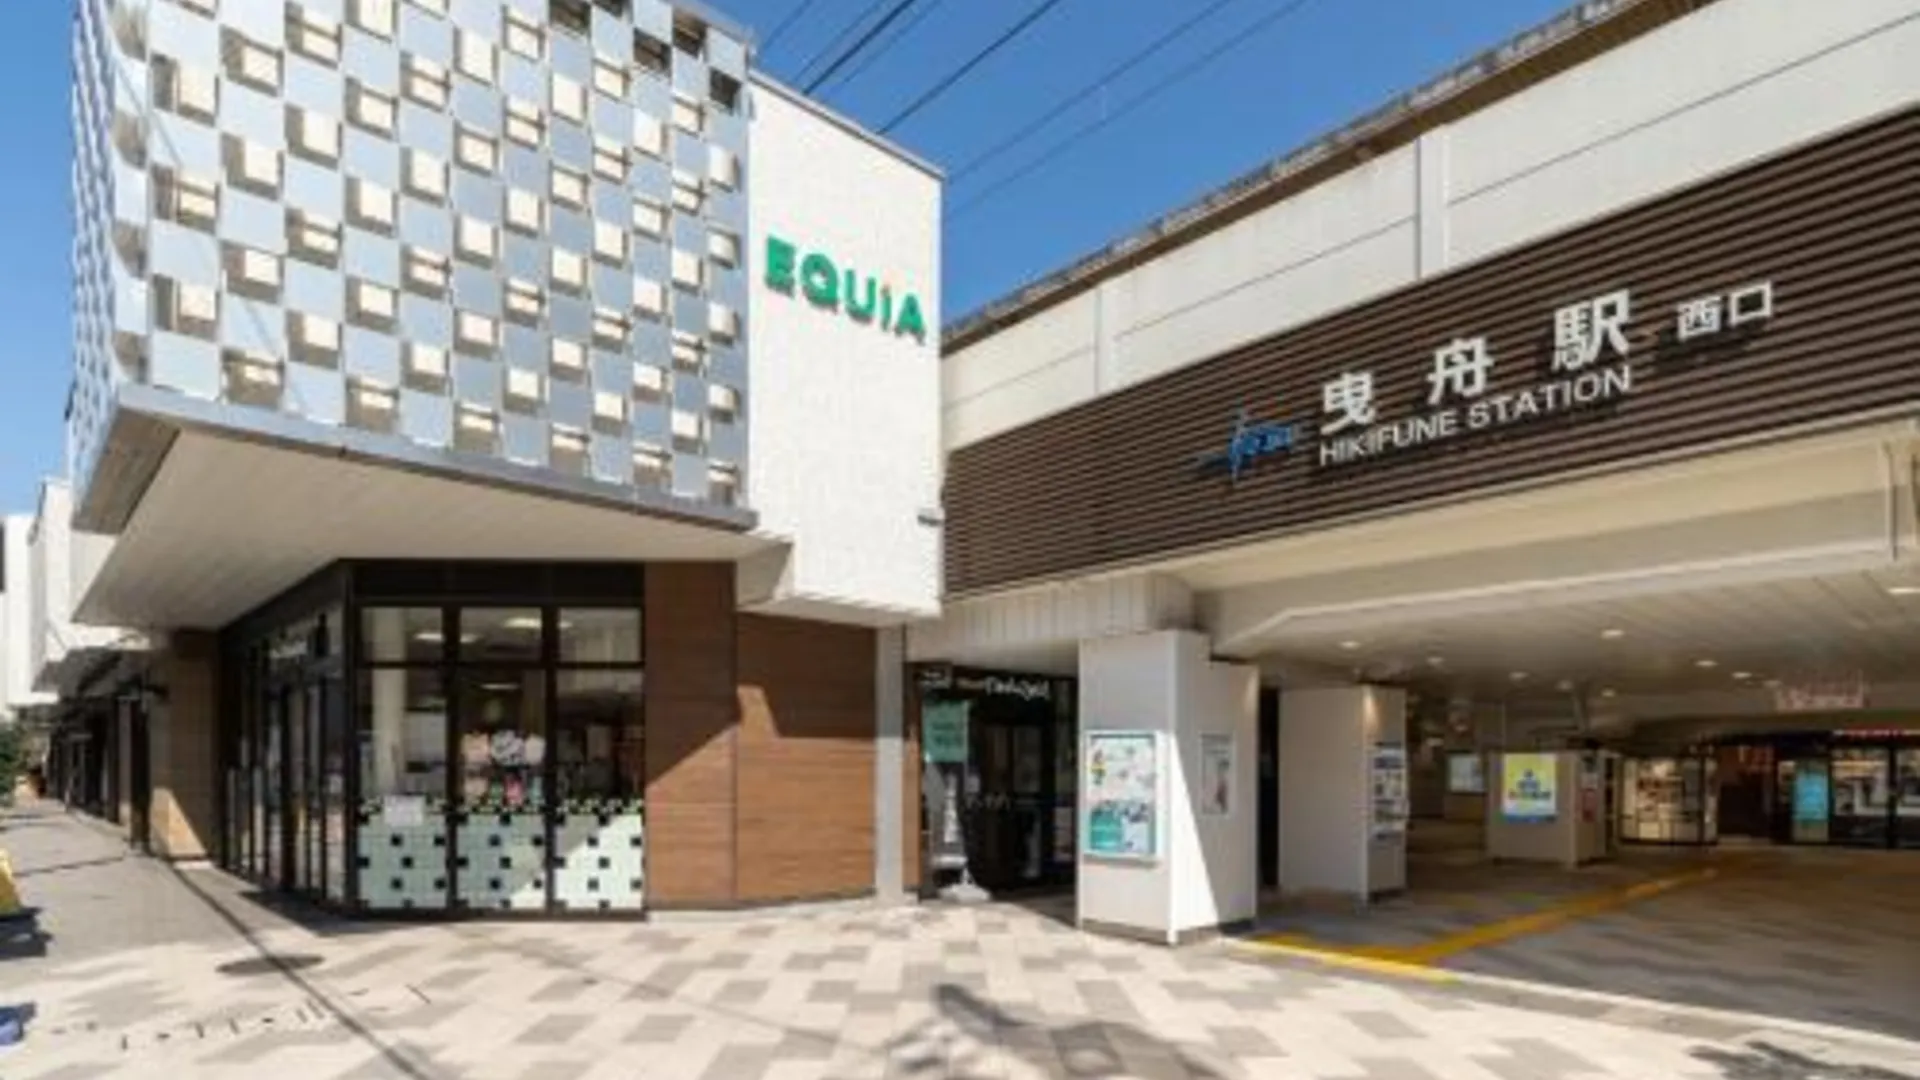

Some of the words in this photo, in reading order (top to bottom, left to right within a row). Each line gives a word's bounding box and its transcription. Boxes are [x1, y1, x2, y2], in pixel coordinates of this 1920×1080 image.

[1679, 281, 1771, 340] 西口
[1320, 408, 1458, 466] HIKIFUNE
[1468, 365, 1631, 429] STATION
